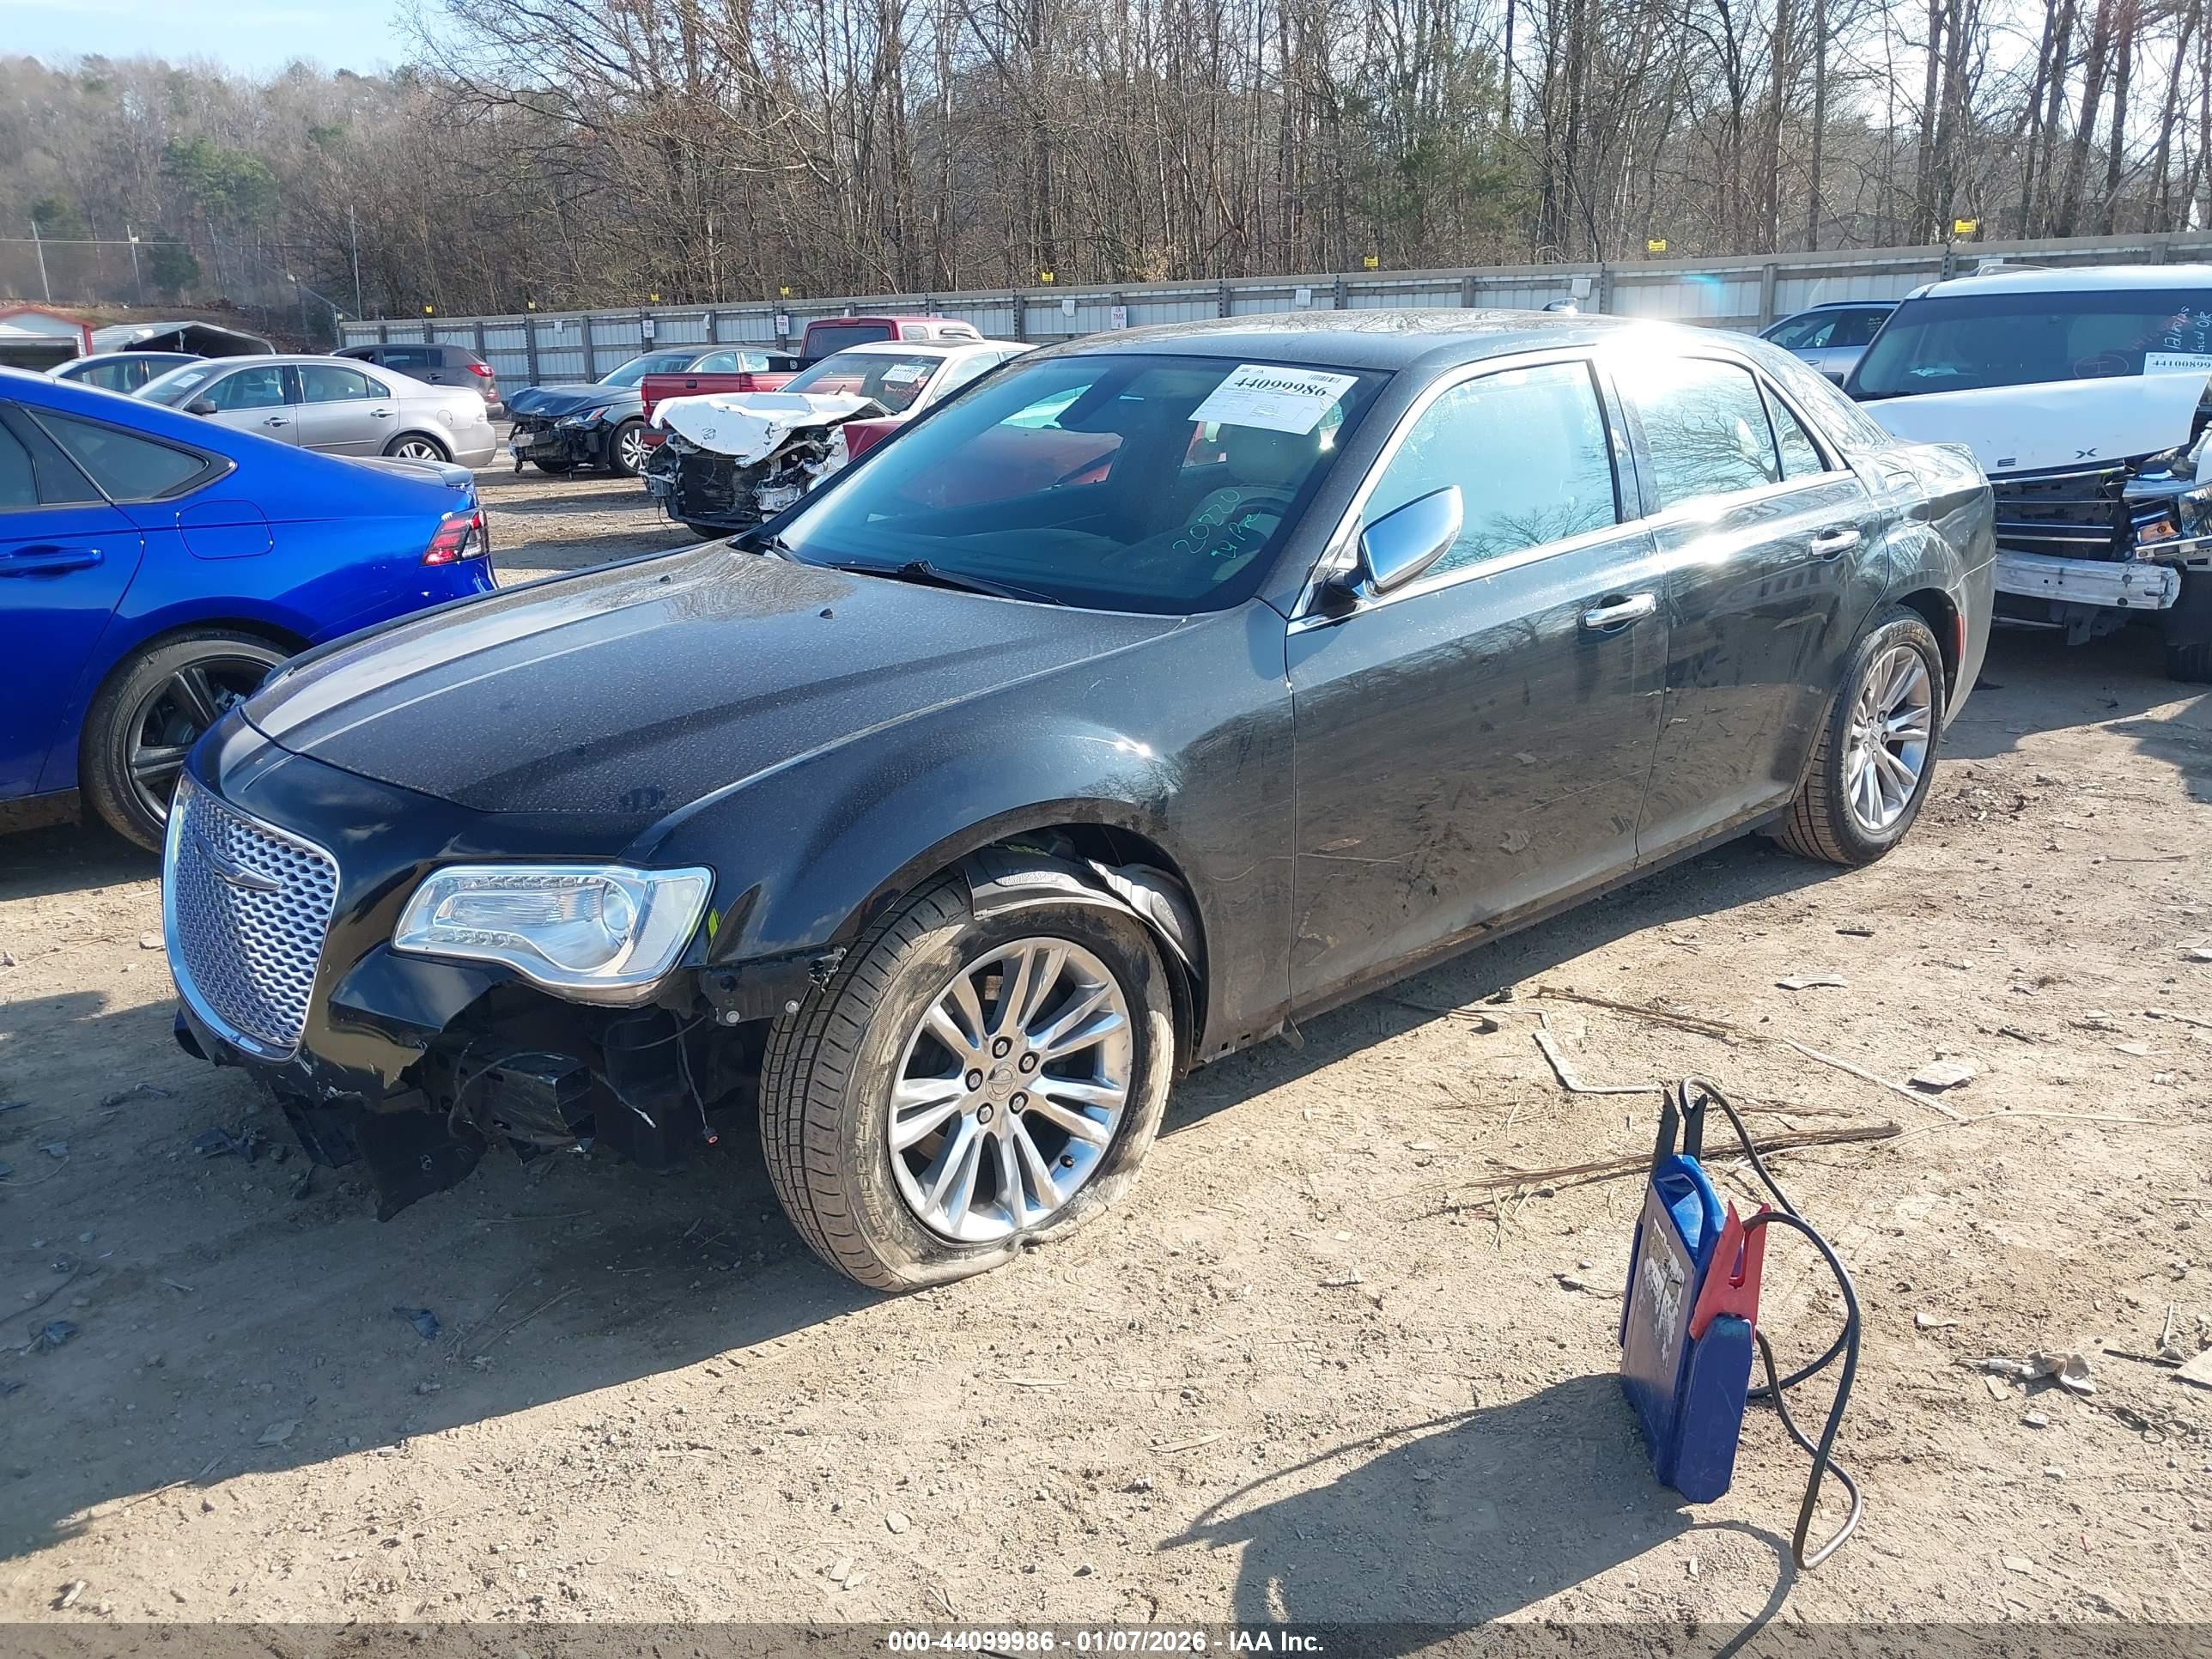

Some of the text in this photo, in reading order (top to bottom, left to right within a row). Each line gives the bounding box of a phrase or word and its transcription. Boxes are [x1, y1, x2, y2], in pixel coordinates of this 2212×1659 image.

[2152, 359, 2212, 369] 44100899
[1234, 377, 1329, 398] 44099986
[855, 1084, 894, 1243] HEMISPHERE
